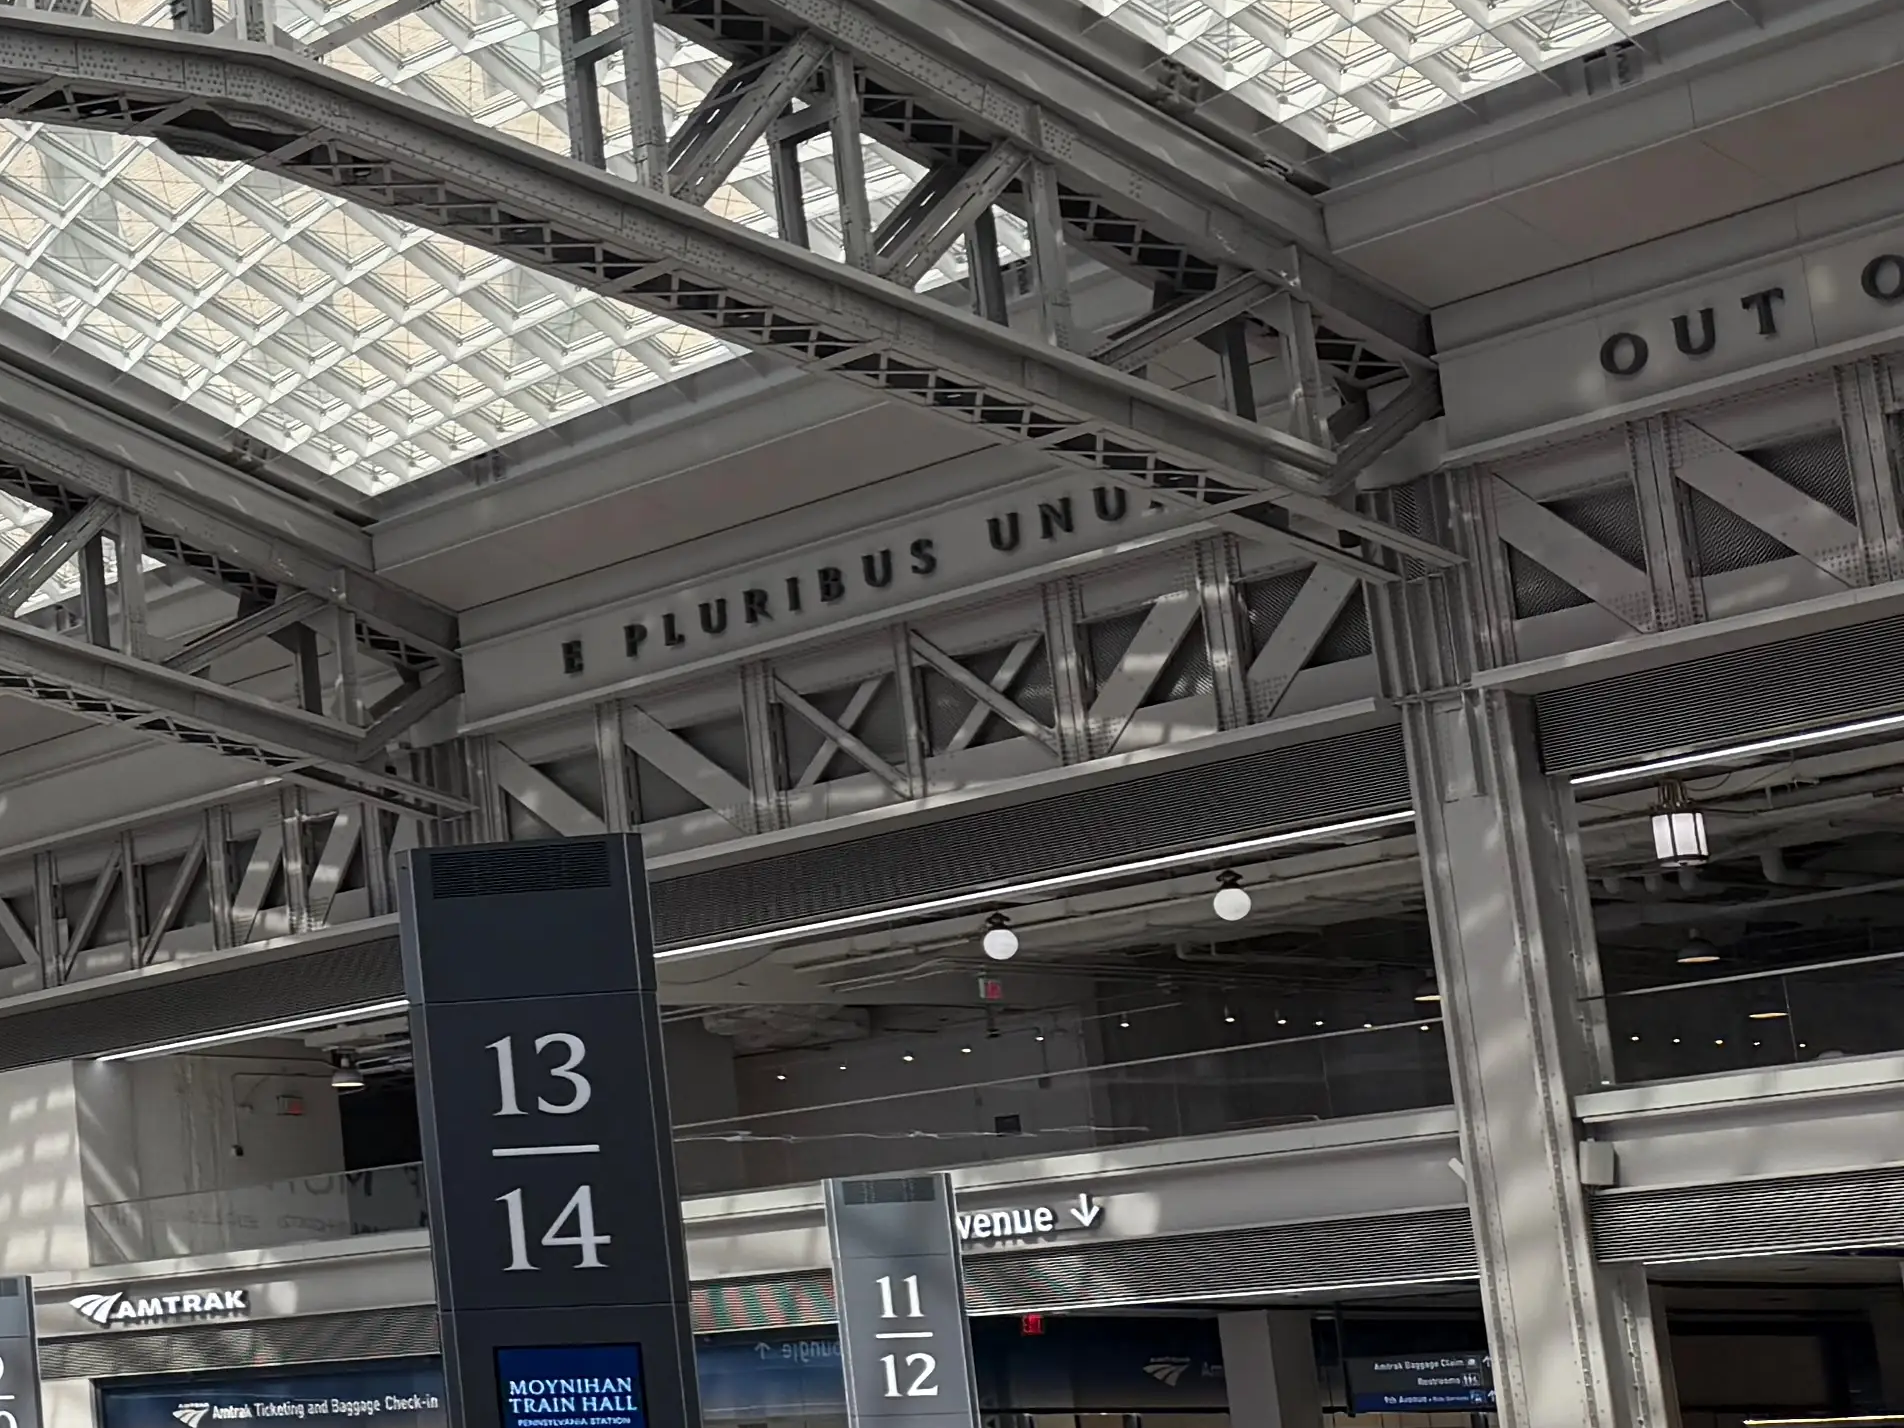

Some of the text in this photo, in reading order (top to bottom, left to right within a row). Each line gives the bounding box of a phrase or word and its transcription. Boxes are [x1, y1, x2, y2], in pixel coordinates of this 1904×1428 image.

[1600, 288, 1784, 375] OUT
[561, 485, 1164, 675] E PLURIBUS UNU
[485, 1032, 592, 1116] 13
[494, 1184, 612, 1271] 14
[956, 1207, 1053, 1239] venue
[116, 1289, 246, 1319] AMTRAK
[875, 1274, 926, 1319] 11
[509, 1377, 632, 1395] MOYNIHAN
[879, 1352, 939, 1397] 12
[212, 1393, 439, 1420] Amtrak Ticketing and Baggage Check-in
[508, 1395, 638, 1413] TRAIN HALL
